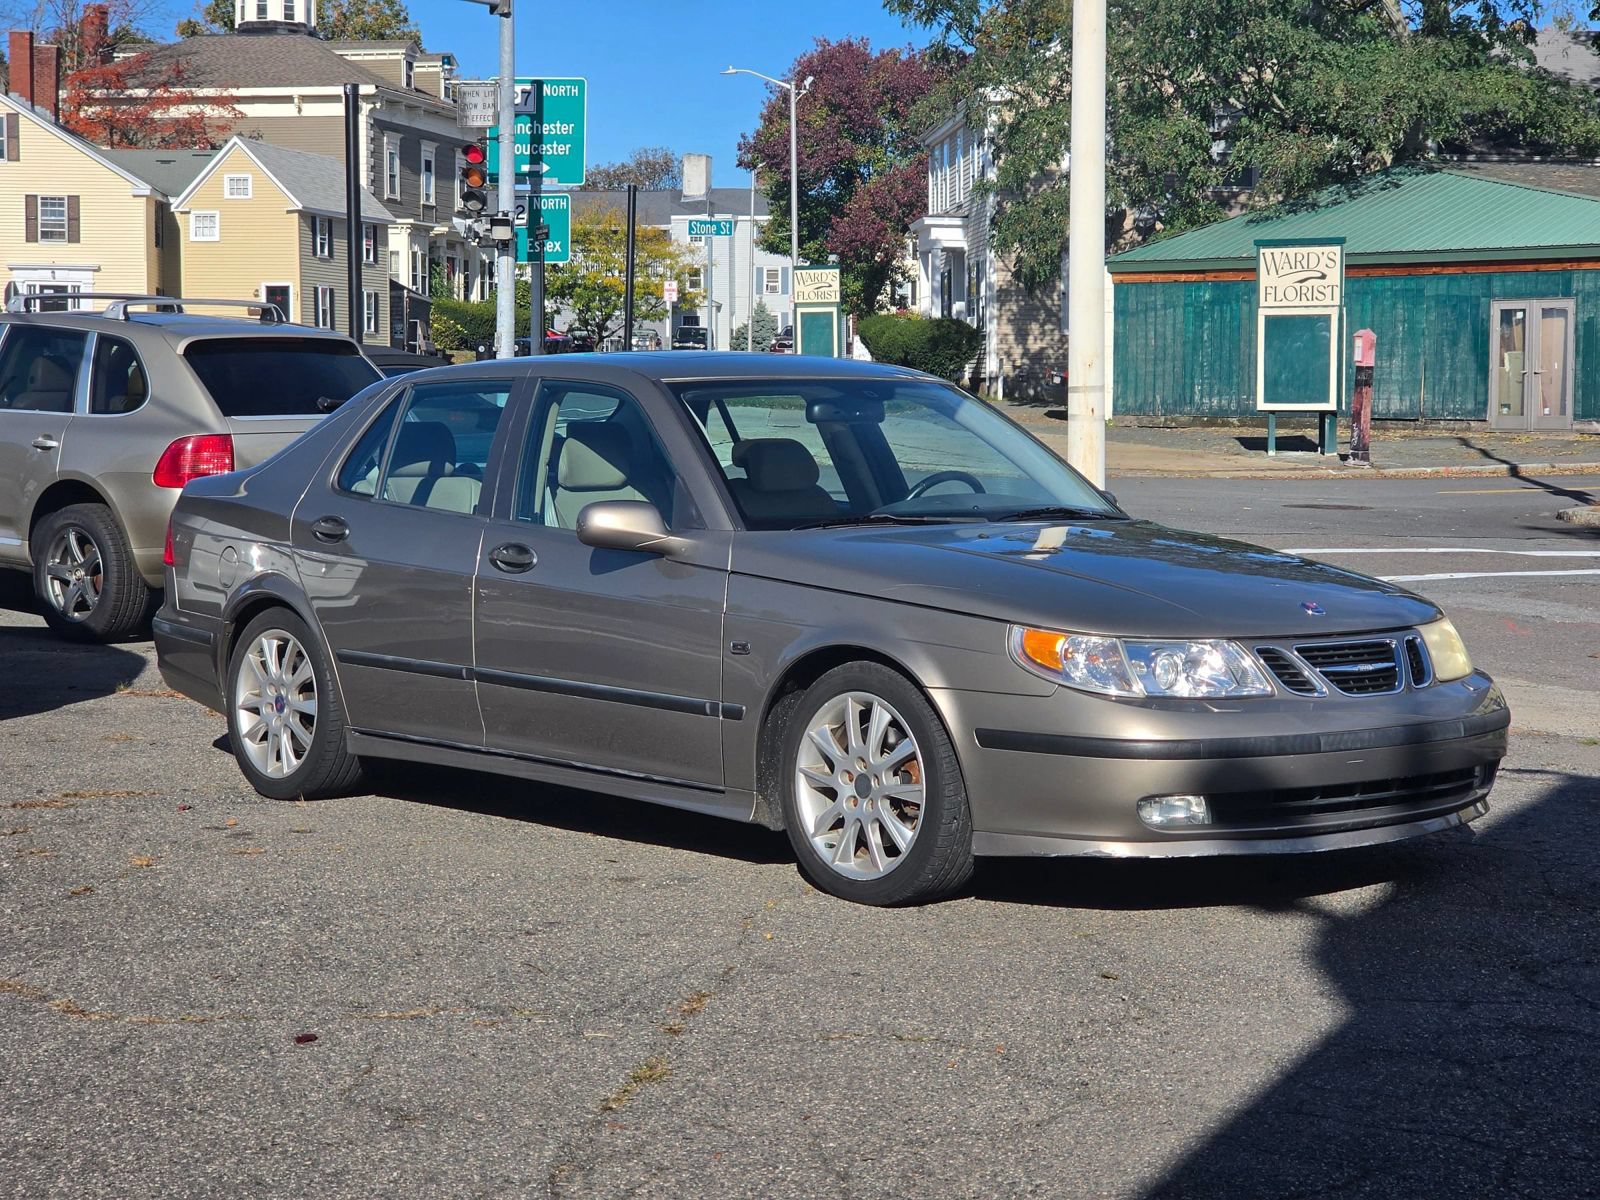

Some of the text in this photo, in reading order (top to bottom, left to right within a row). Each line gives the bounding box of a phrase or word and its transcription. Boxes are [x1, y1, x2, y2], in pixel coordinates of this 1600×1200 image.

[543, 84, 579, 97] NORTH
[514, 120, 575, 135] nchester
[514, 140, 571, 155] oucester
[515, 197, 567, 220] 2 NORTH
[691, 221, 731, 235] Stone St
[1261, 251, 1338, 276] WARD'S
[795, 271, 838, 286] WARD'S
[796, 290, 839, 301] FLORIST
[1264, 284, 1339, 302] FLORIST
